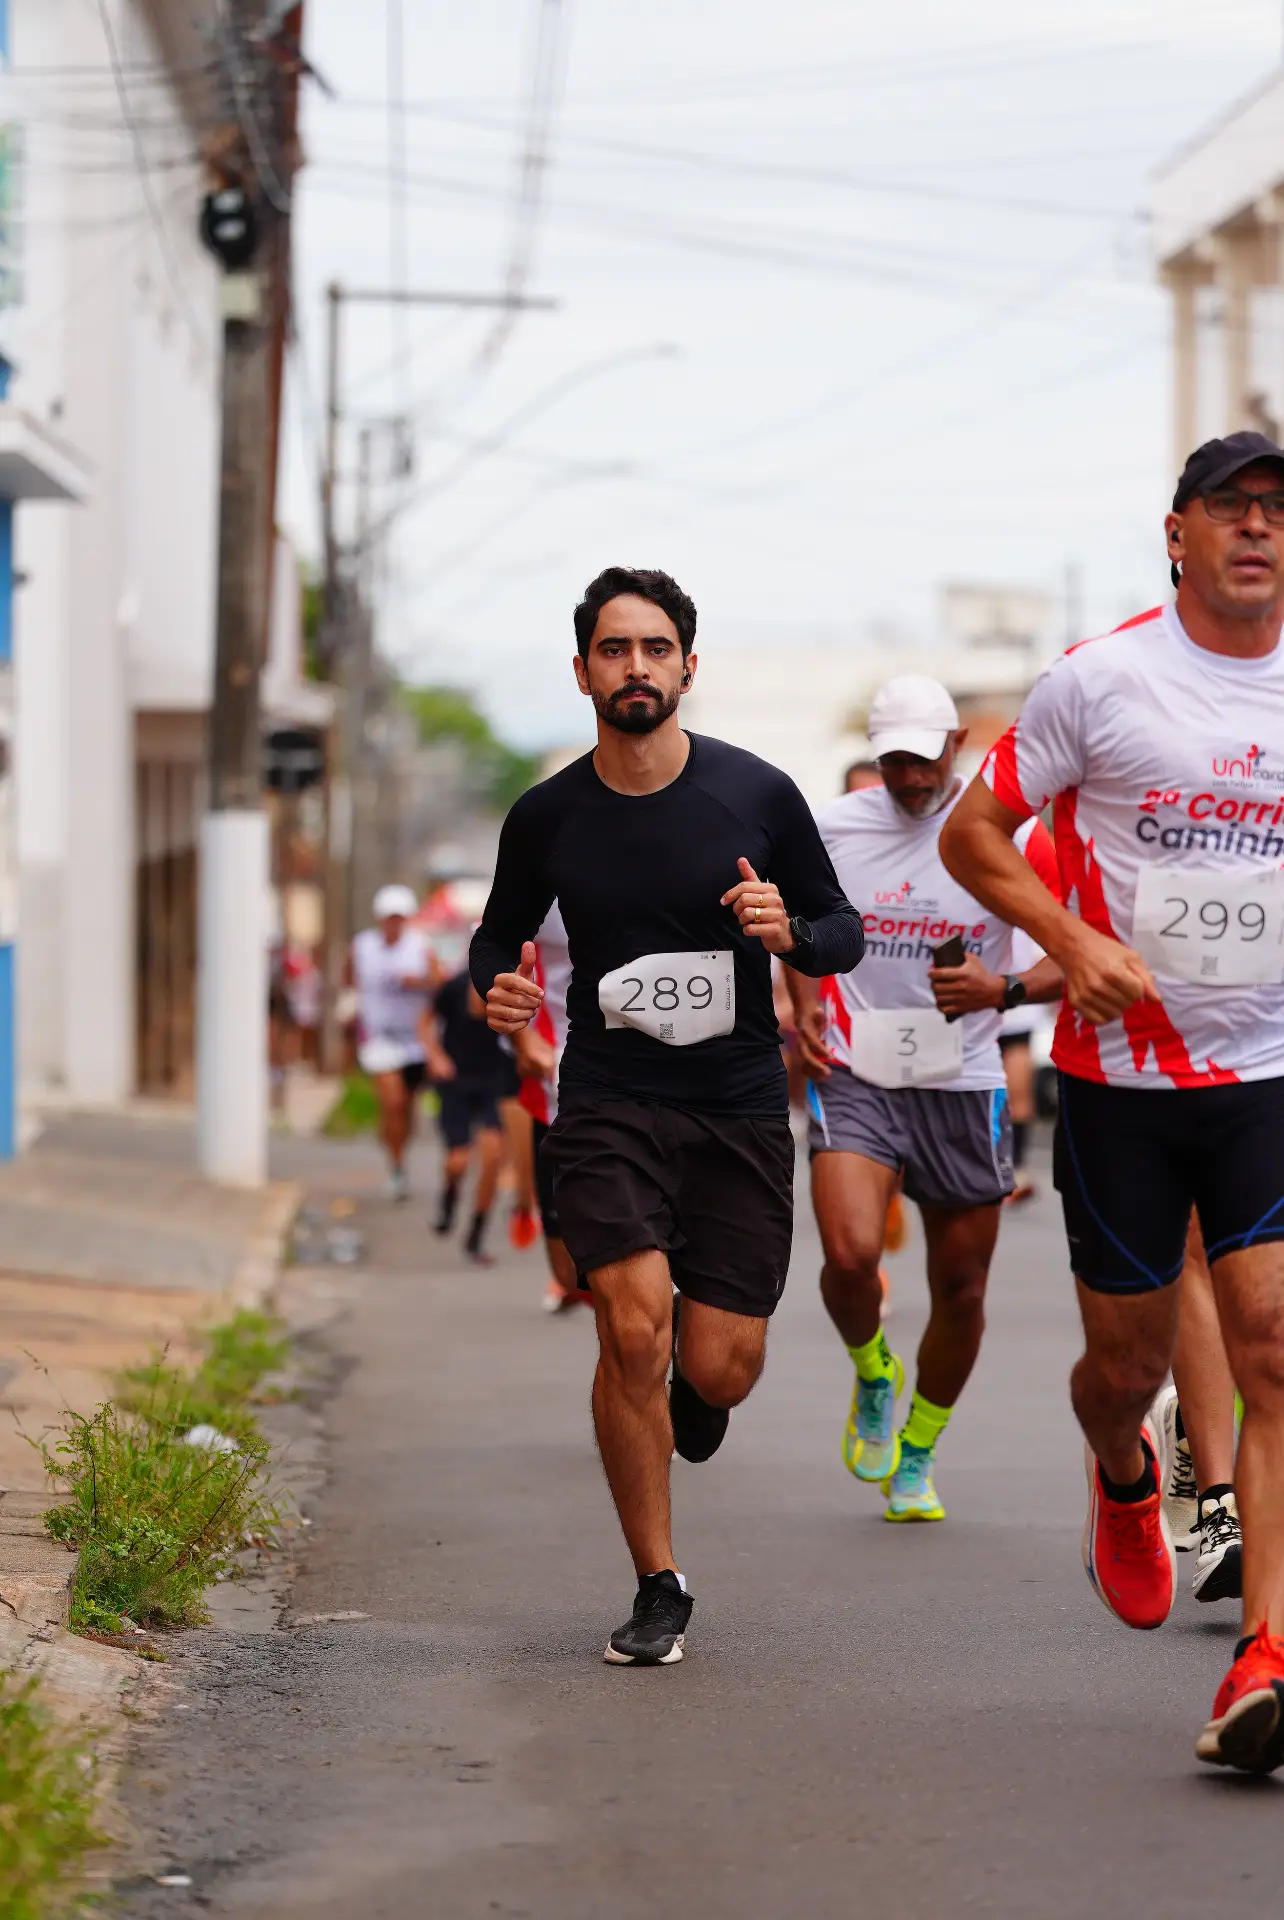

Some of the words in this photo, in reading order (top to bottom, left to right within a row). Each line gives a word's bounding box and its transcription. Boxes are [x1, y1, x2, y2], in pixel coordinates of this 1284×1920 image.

[1187, 792, 1284, 825] Corri
[1136, 816, 1284, 857] Caminh
[971, 922, 986, 938] e
[1159, 897, 1266, 942] 299
[864, 935, 983, 960] minha
[620, 975, 713, 1012] 289
[897, 1027, 918, 1056] 3
